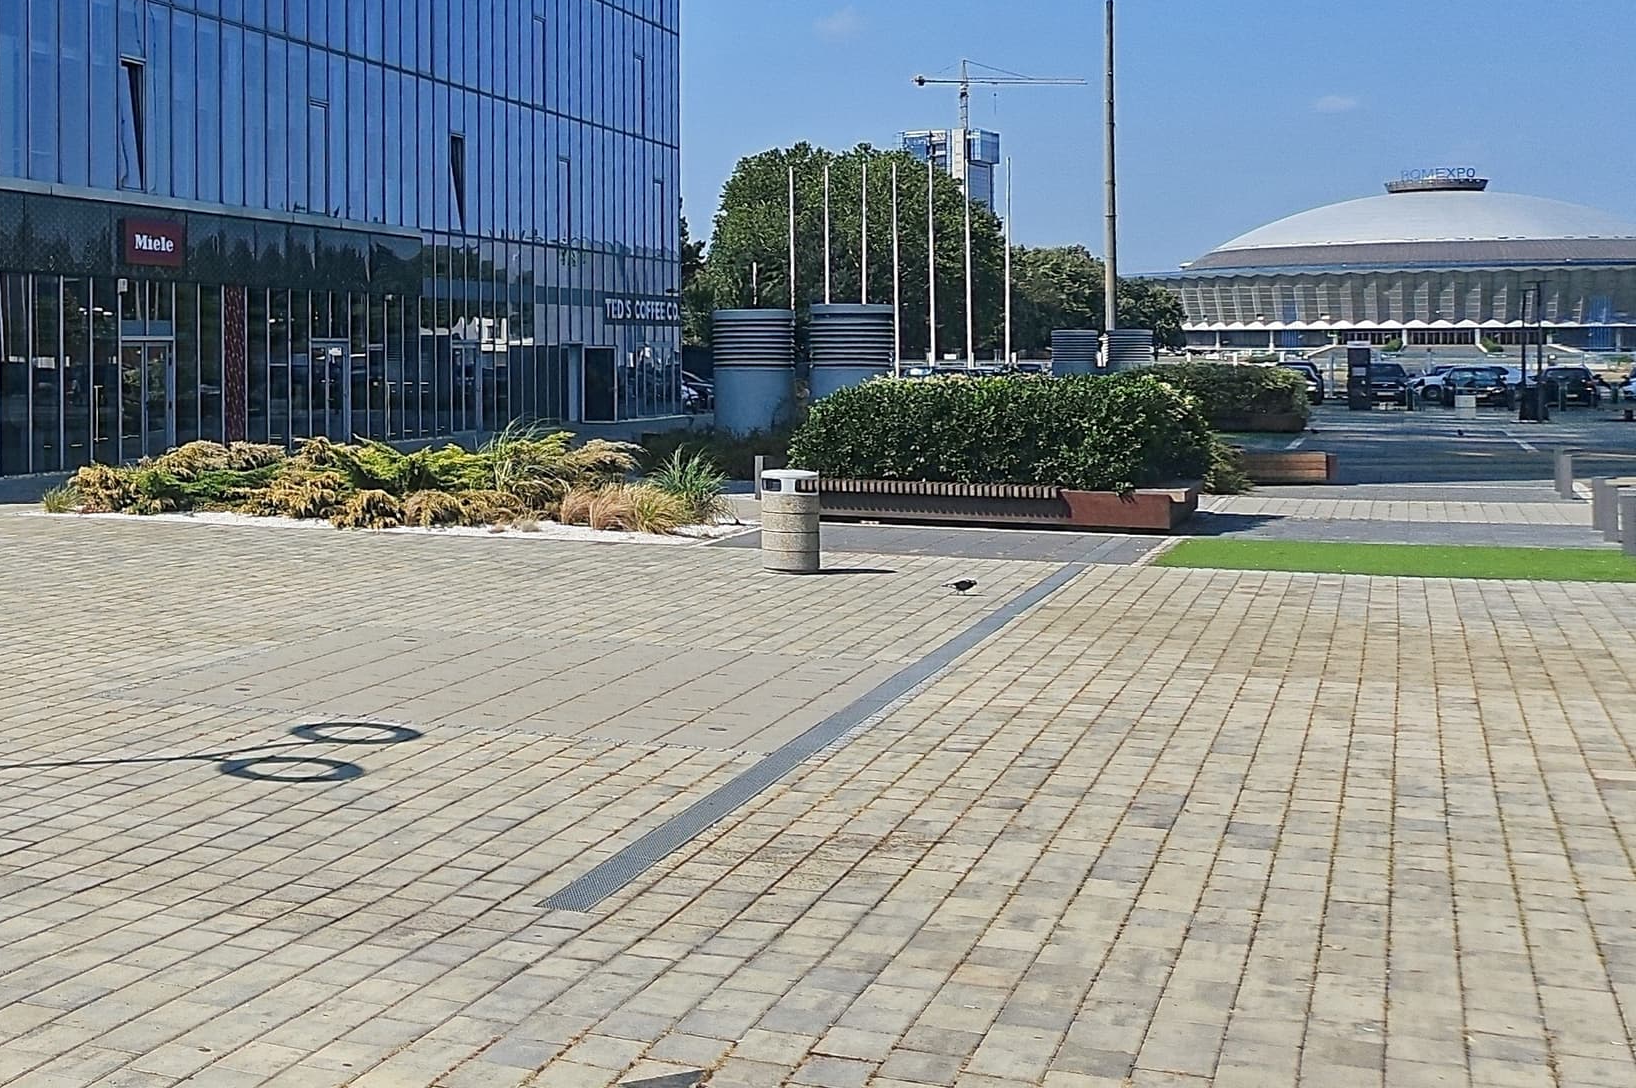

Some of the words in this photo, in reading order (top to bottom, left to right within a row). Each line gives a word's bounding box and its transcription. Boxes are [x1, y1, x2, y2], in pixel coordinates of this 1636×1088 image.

[1401, 167, 1475, 179] ROMEXPO
[134, 234, 174, 252] Miele
[635, 300, 665, 320] COFFEE
